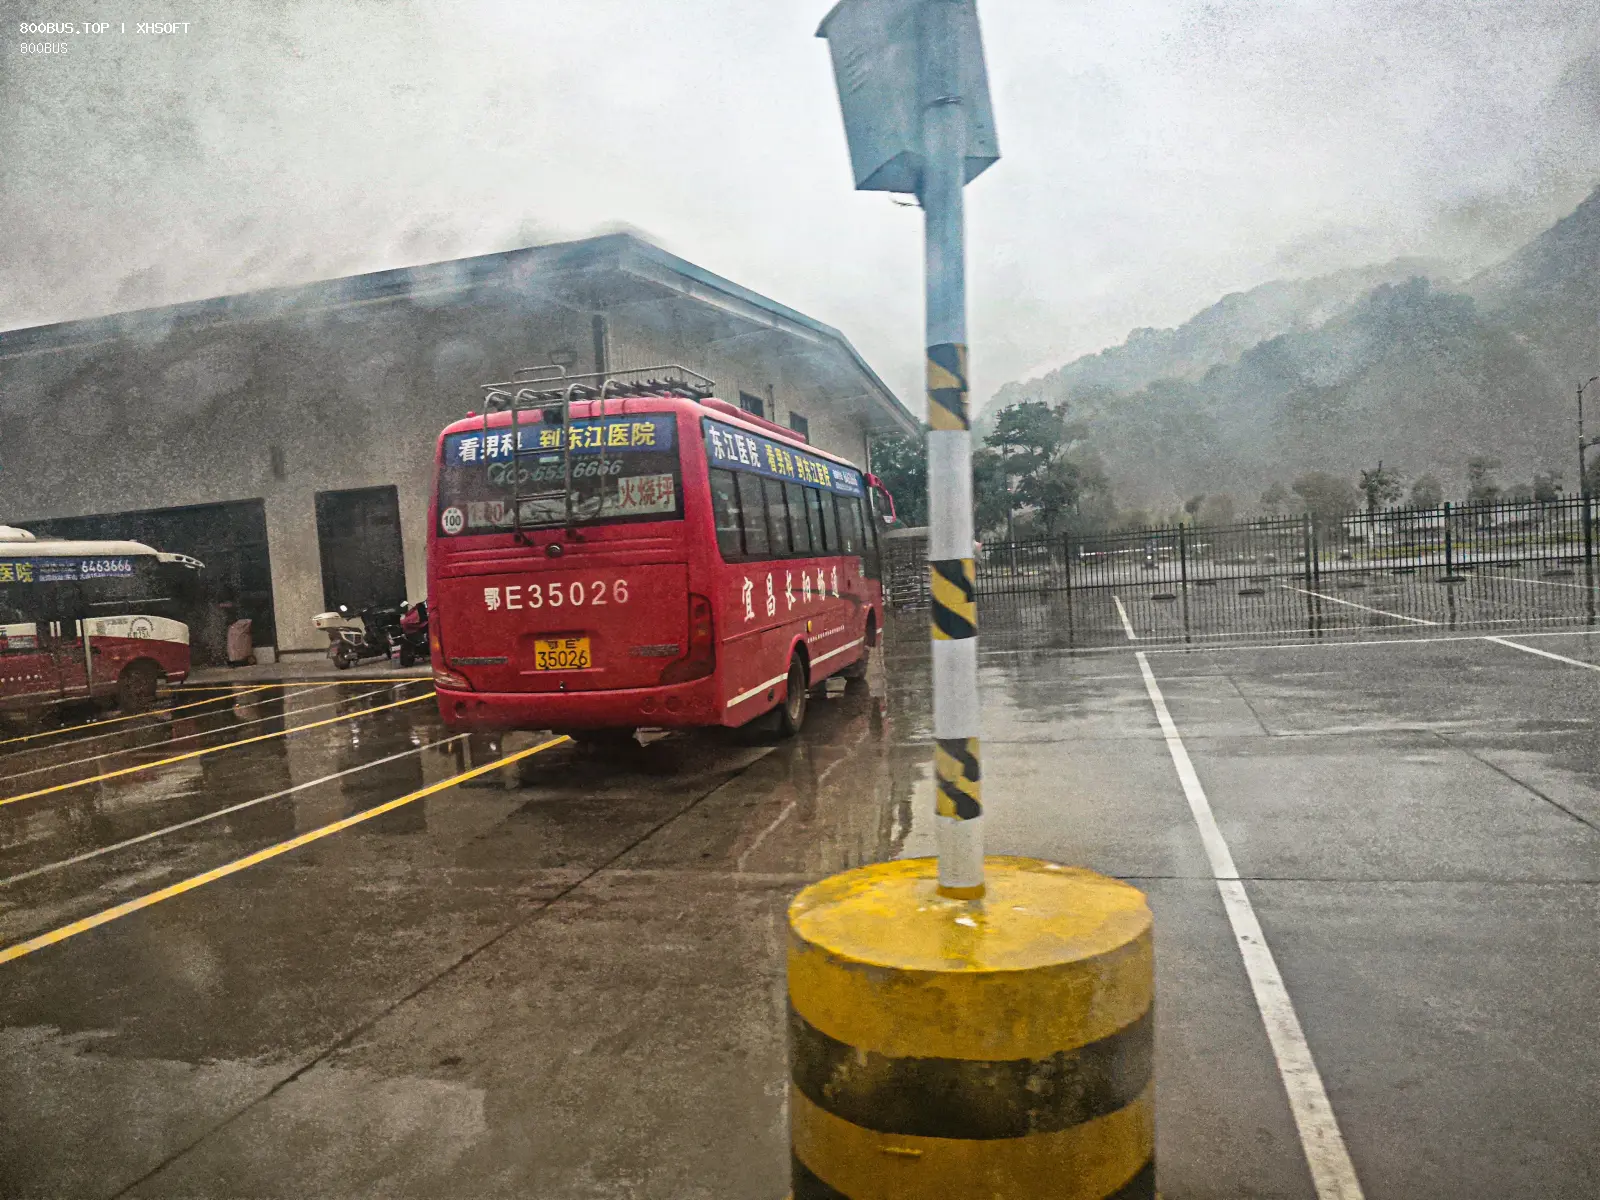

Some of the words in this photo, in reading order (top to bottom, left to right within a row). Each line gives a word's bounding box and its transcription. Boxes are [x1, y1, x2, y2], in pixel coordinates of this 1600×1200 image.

[458, 431, 522, 462] 看男科
[539, 421, 655, 450] 到东江医院
[709, 425, 761, 468] 东江医院
[618, 476, 676, 508] 火烧坪
[443, 515, 461, 526] 100
[81, 559, 131, 573] 6463666
[484, 579, 629, 611] 鄂E35026
[538, 650, 588, 668] 35026
